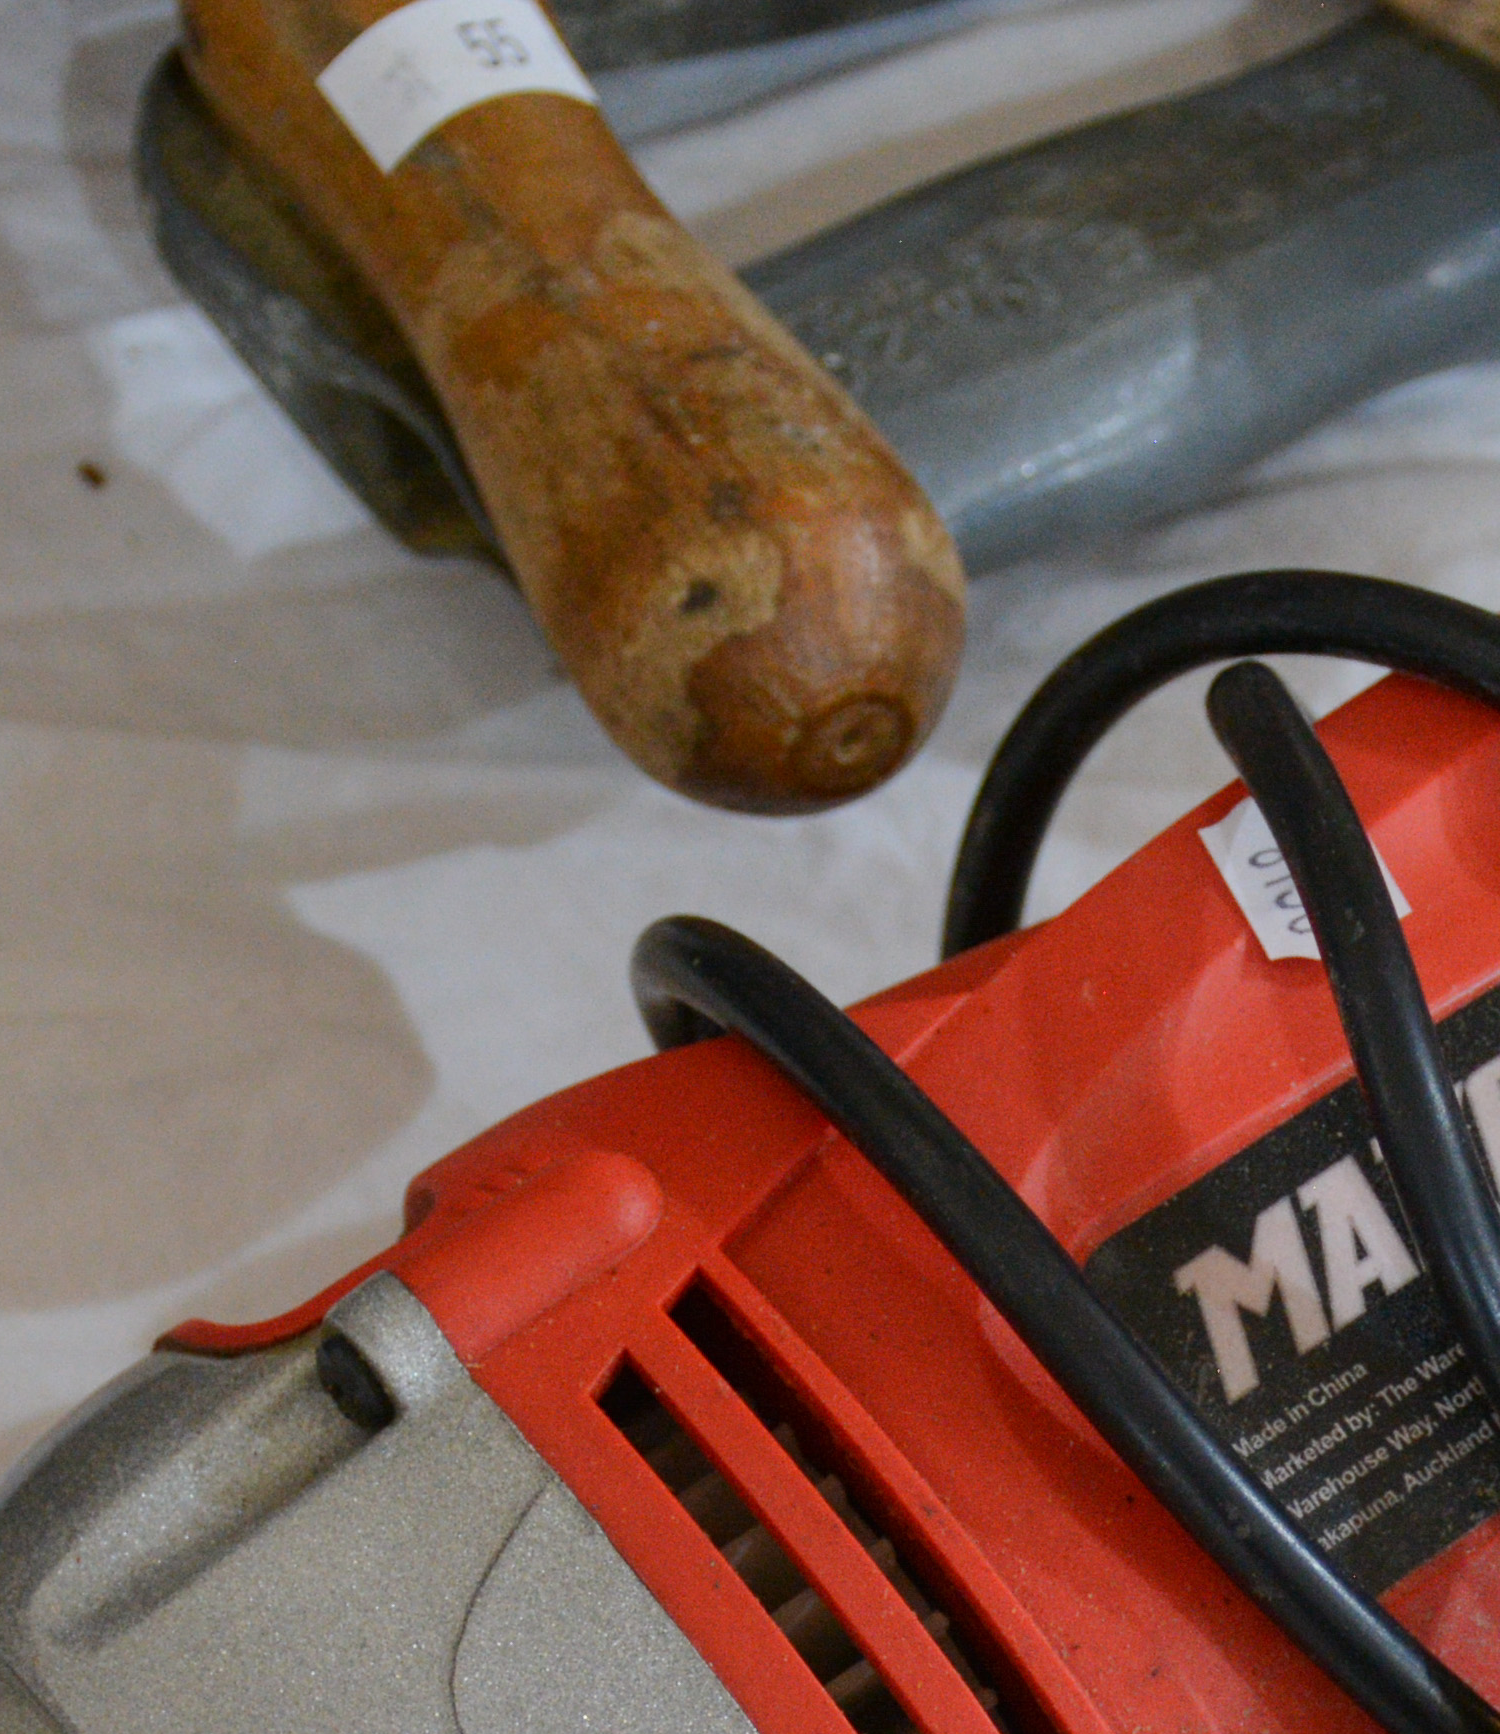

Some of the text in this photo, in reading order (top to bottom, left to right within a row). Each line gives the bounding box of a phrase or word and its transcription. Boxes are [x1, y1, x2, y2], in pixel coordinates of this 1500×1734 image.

[1283, 1402, 1310, 1424] in
[1303, 1362, 1368, 1407] China
[1342, 1402, 1380, 1432] by:
[1373, 1376, 1419, 1407] The
[1316, 1489, 1404, 1552] akapuna,
[1401, 1419, 1493, 1494] Auckland
